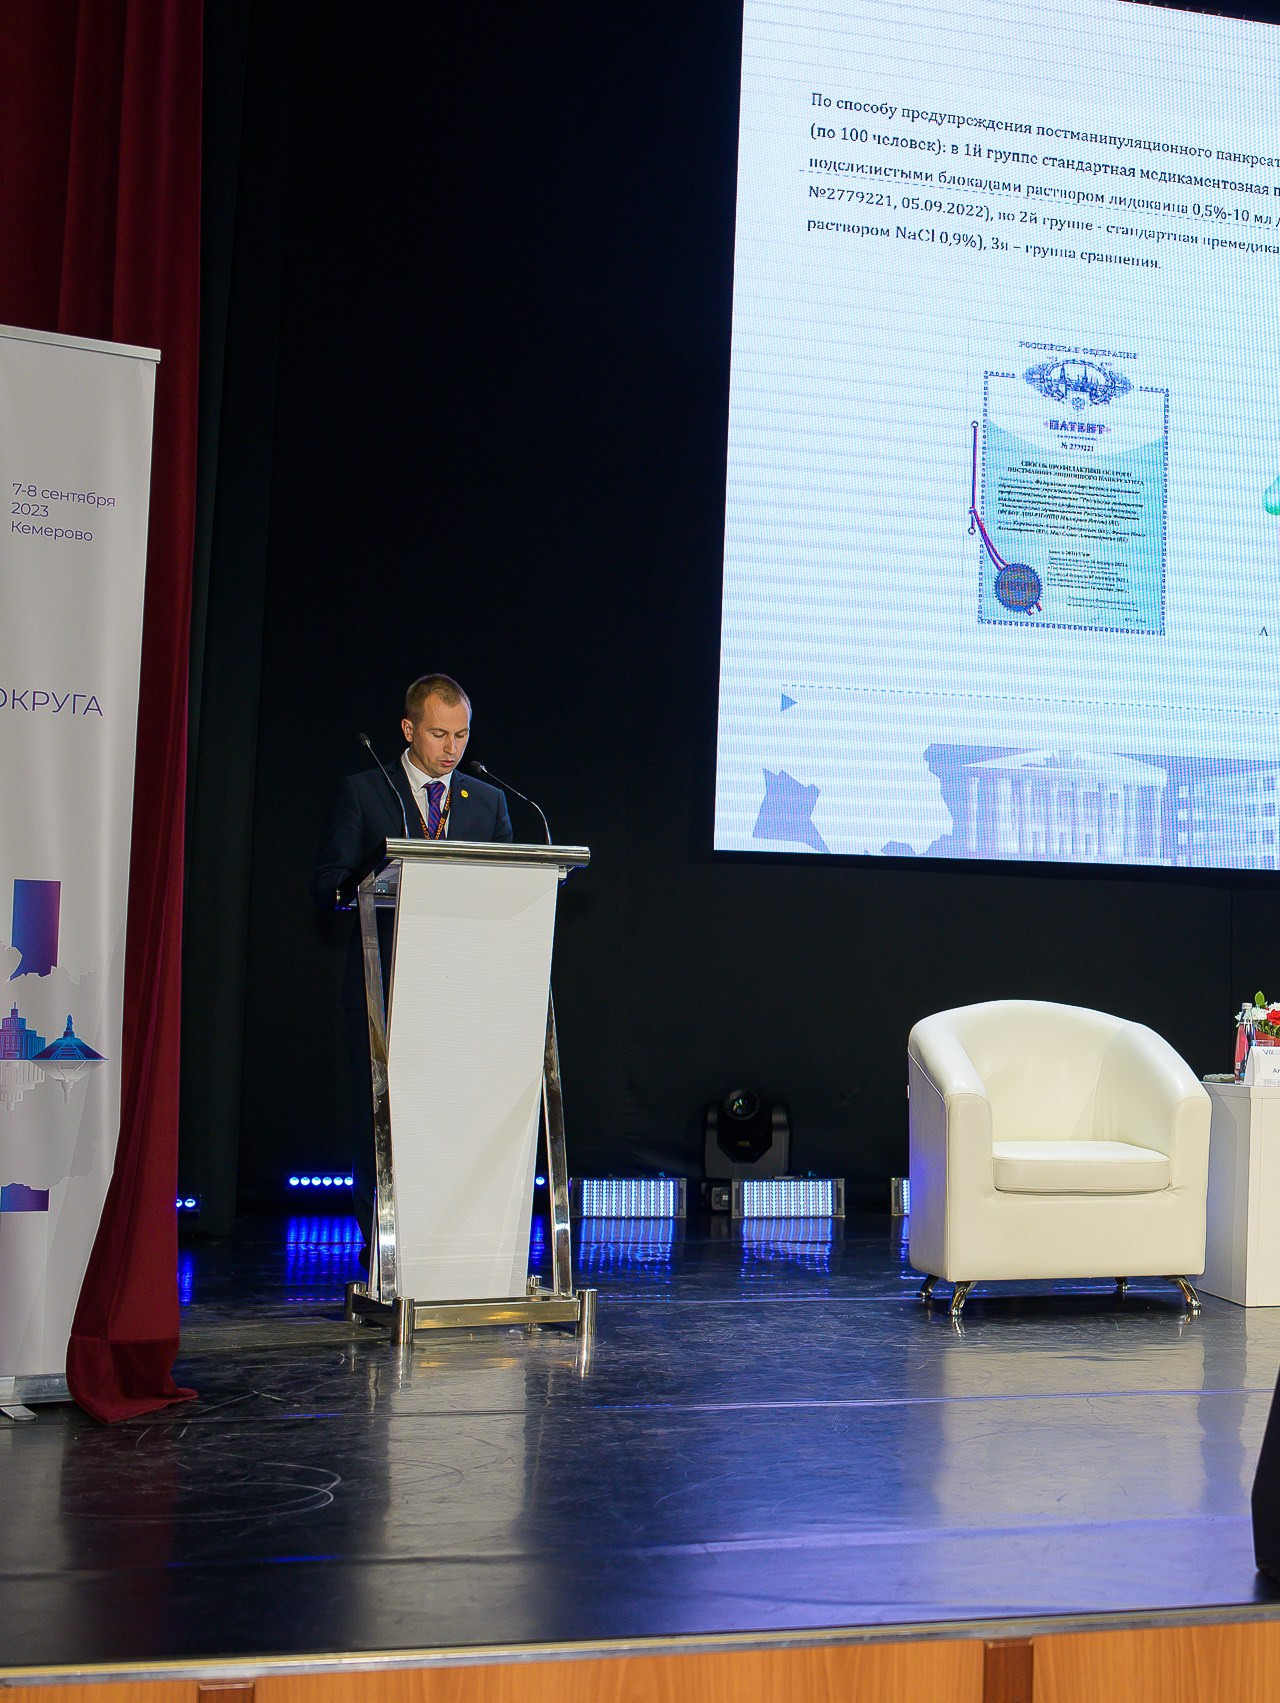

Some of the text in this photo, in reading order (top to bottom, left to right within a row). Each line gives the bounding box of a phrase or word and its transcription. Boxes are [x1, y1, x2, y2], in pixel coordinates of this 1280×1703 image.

[811, 92, 832, 108] По
[836, 99, 898, 119] способу
[901, 107, 1032, 134] предупреждения
[1036, 125, 1212, 158] постманипуляционного
[810, 122, 836, 140] (по
[841, 127, 869, 142] 100
[873, 134, 947, 156] человек):
[951, 144, 959, 154] в
[964, 143, 983, 158] 1й
[986, 149, 1038, 165] группе
[1042, 156, 1136, 178] стандартная
[1140, 169, 1270, 196] медикаментозная
[808, 185, 898, 210] №2779221,
[901, 196, 994, 222] 05.09.2022),
[998, 211, 1015, 221] во
[1019, 211, 1038, 224] 2й
[1042, 217, 1093, 231] группе
[1106, 224, 1198, 244] стандартная
[809, 158, 934, 182] подслизистыми
[938, 171, 1022, 192] блокадами
[1026, 185, 1105, 204] раствором
[1109, 195, 1188, 214] лидокаина
[1192, 203, 1250, 222] 0,5%-10
[1254, 214, 1272, 225] мл
[807, 219, 890, 238] раствором
[895, 225, 935, 243] NaCl
[939, 231, 987, 251] 0,9%),
[991, 237, 1009, 251] 3я
[1025, 244, 1076, 259] группа
[1080, 251, 1162, 269] сравнения.
[1049, 419, 1106, 435] ПАТЕНТ
[11, 502, 50, 518] 2023
[12, 482, 116, 508] 7-8 сентября
[11, 521, 94, 542] Кемерово
